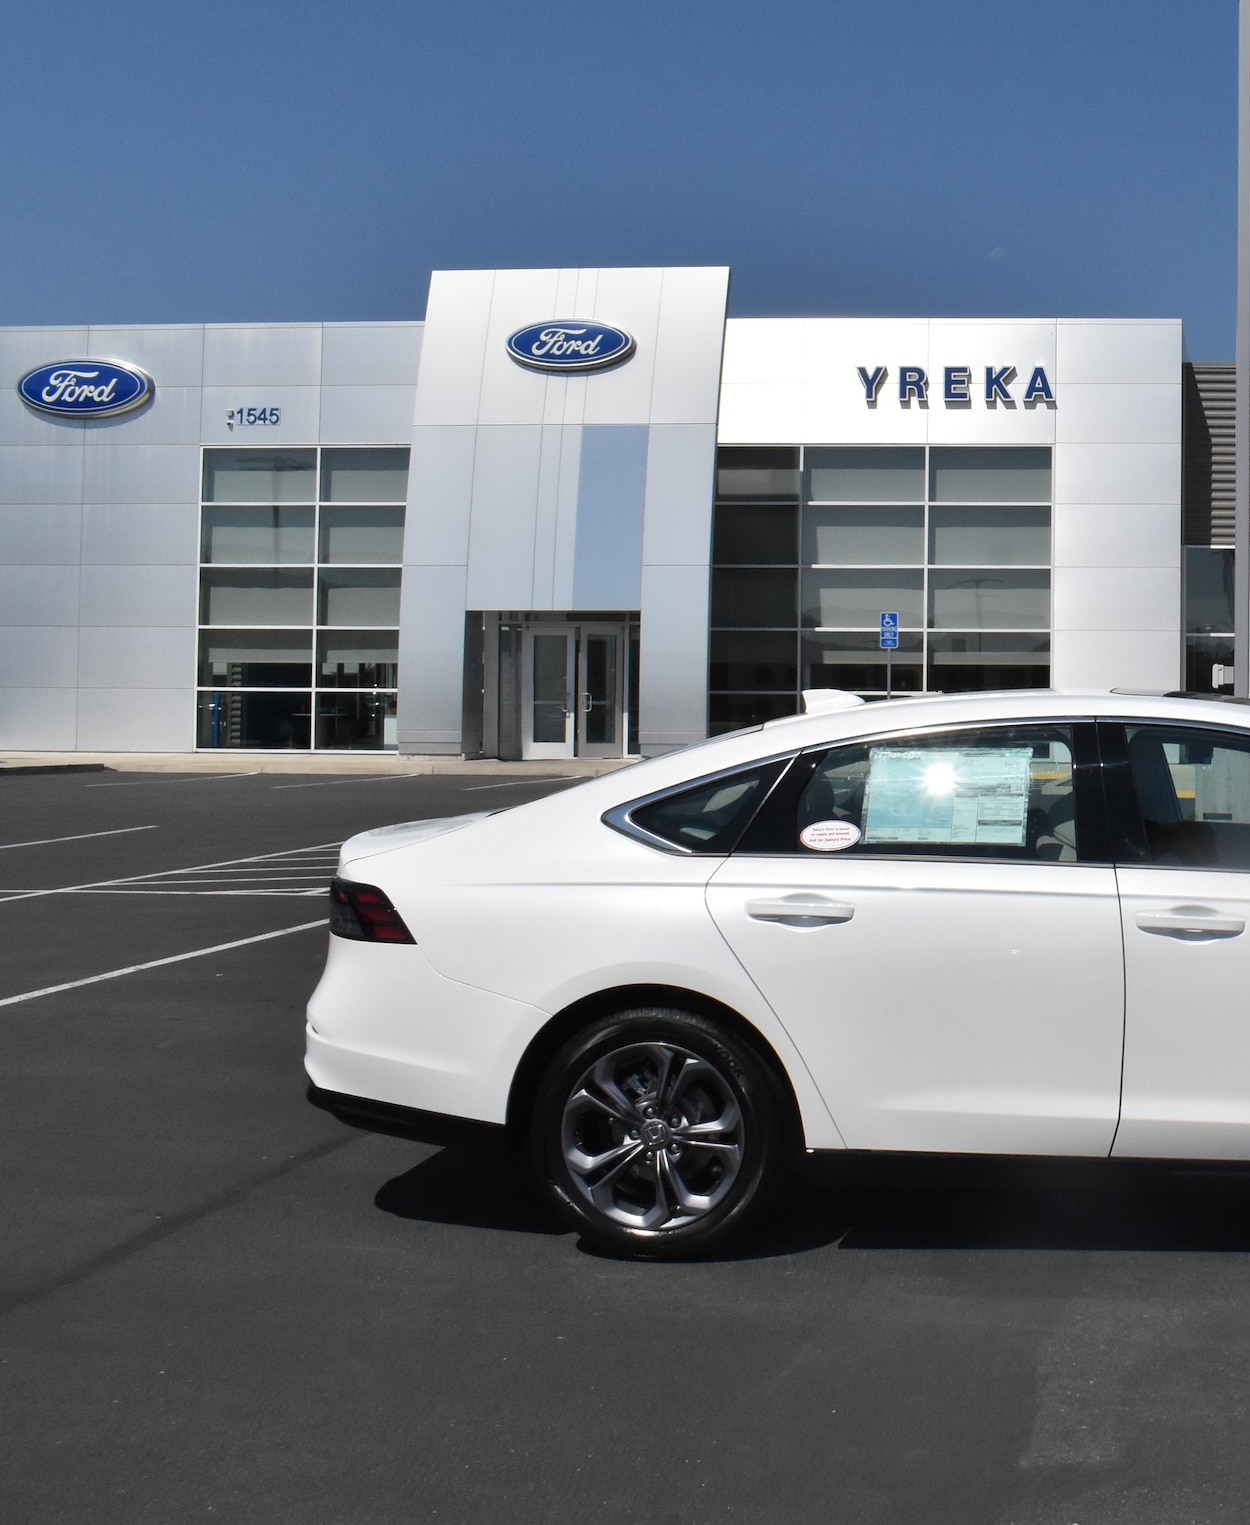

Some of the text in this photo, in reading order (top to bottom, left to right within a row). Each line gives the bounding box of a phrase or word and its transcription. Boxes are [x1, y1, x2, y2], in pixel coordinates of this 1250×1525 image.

[531, 328, 604, 356] Ford
[41, 370, 118, 403] Ford
[856, 366, 1056, 402] YREKA
[236, 407, 280, 425] 1545
